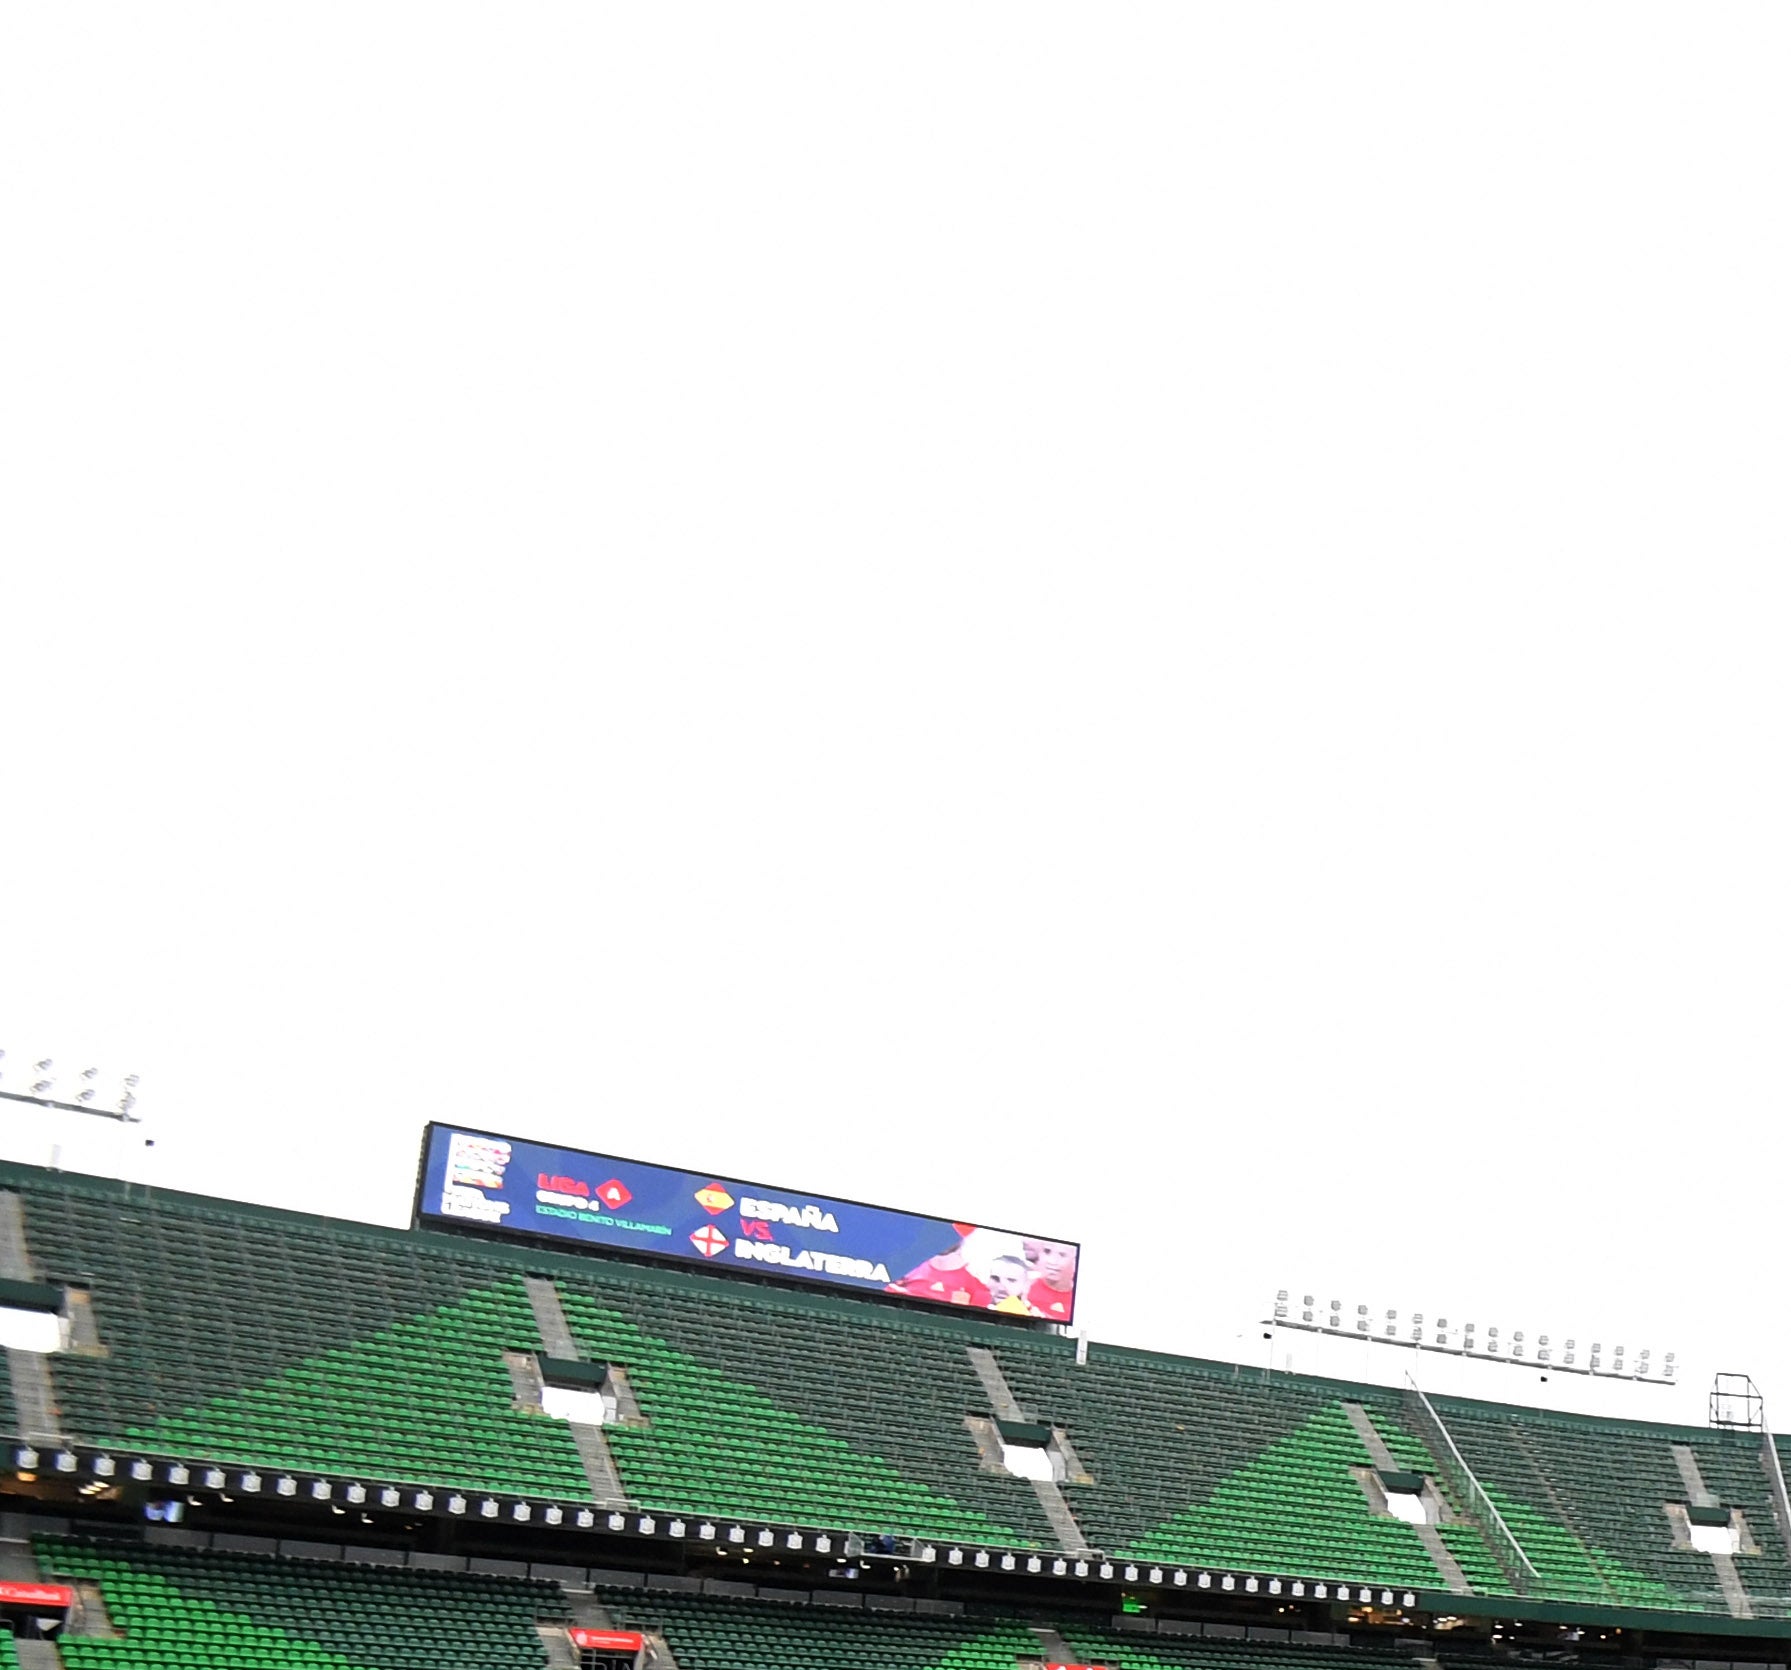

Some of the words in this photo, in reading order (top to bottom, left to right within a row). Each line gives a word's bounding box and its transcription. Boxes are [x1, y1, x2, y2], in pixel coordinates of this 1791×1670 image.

[740, 1197, 839, 1233] ESPAÑA
[740, 1218, 773, 1241] VS
[735, 1238, 891, 1282] INGLATERRA
